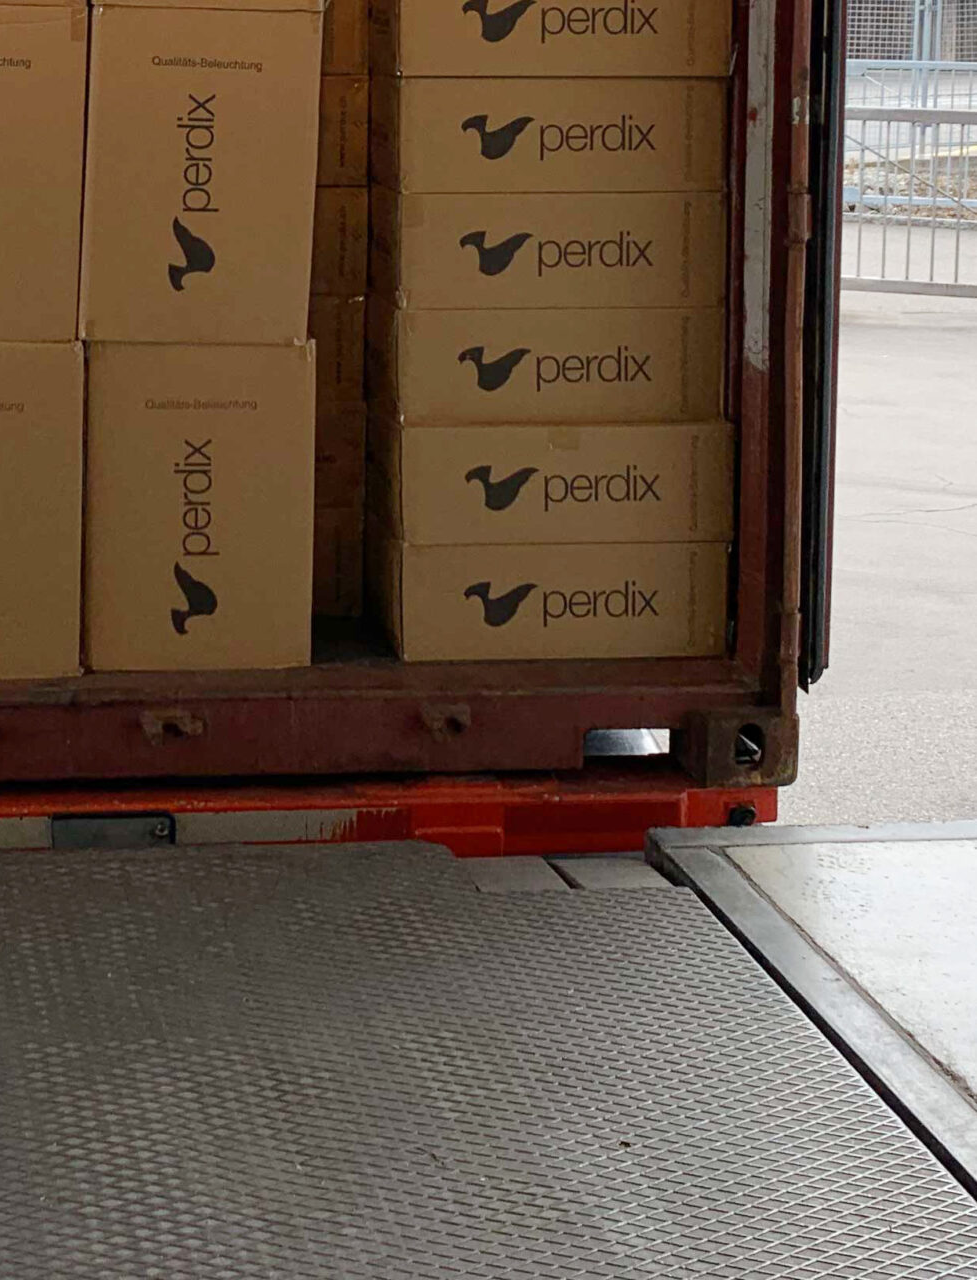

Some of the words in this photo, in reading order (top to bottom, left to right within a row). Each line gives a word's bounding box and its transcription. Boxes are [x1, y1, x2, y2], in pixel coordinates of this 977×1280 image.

[151, 55, 263, 74] Qualitäts-Beleuchtung
[173, 94, 219, 213] perdix
[539, 115, 655, 161] perdix
[537, 231, 652, 277] perdix
[535, 346, 651, 392] perdix
[174, 439, 219, 557] perdix
[543, 465, 660, 512] perdix
[542, 581, 658, 627] perdix
